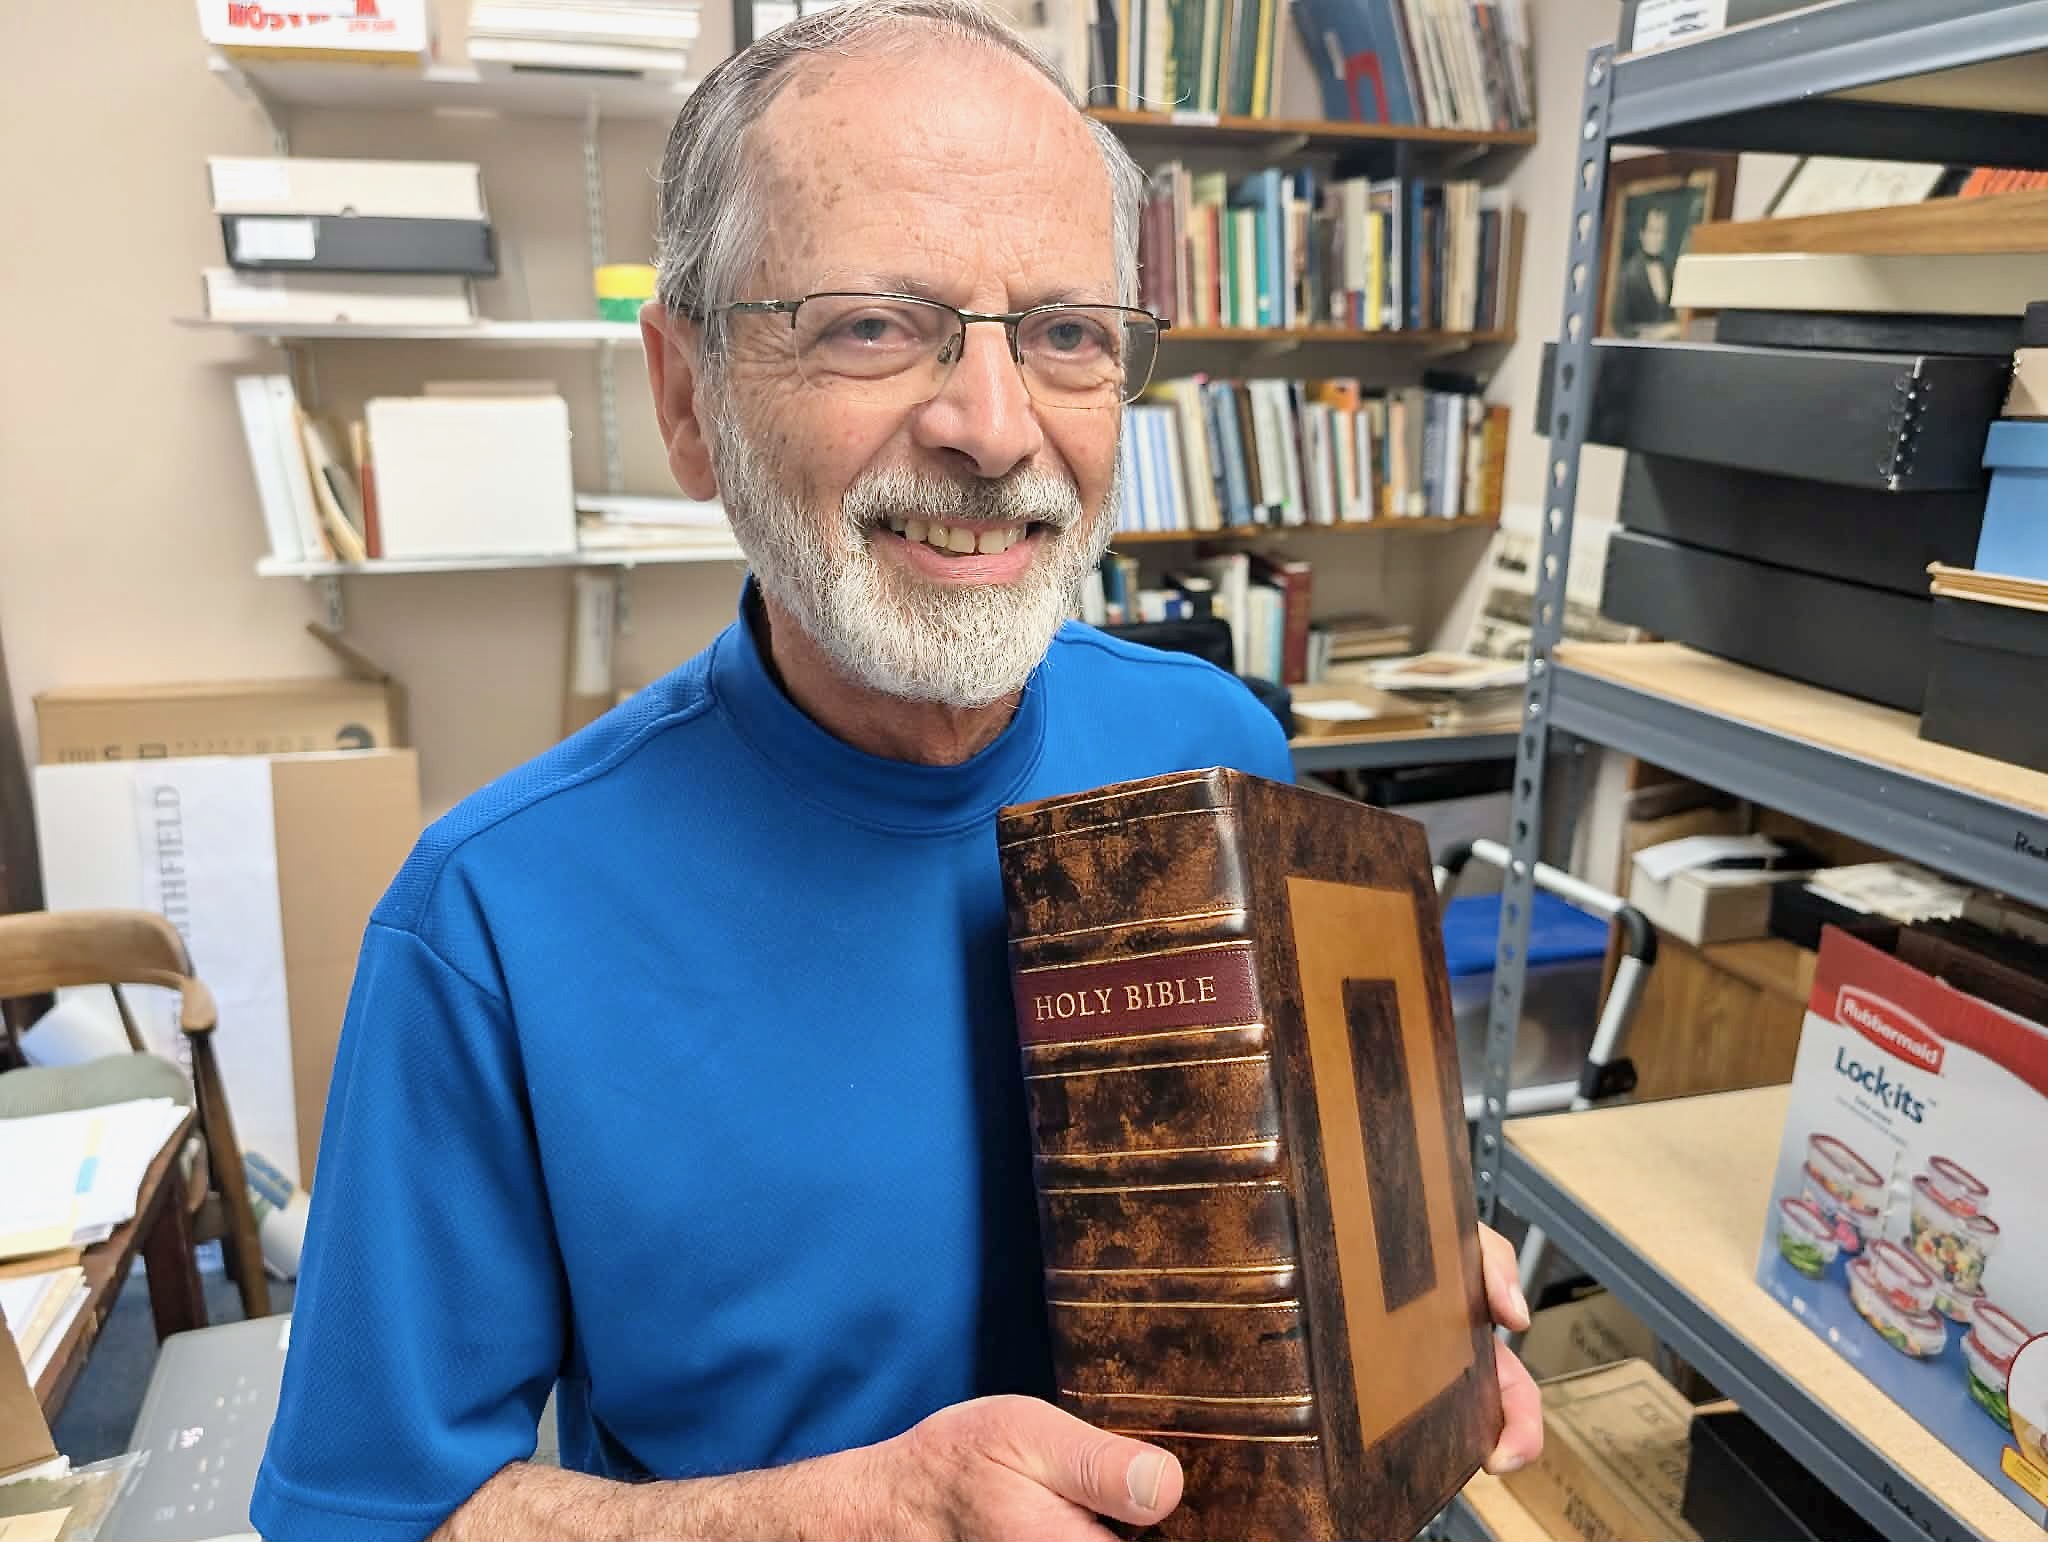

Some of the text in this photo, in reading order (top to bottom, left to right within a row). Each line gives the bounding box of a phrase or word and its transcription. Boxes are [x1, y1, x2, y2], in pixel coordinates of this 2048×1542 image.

[1034, 975, 1217, 1022] HOLY BIBLE
[1843, 998, 1938, 1065] Rubbermaid
